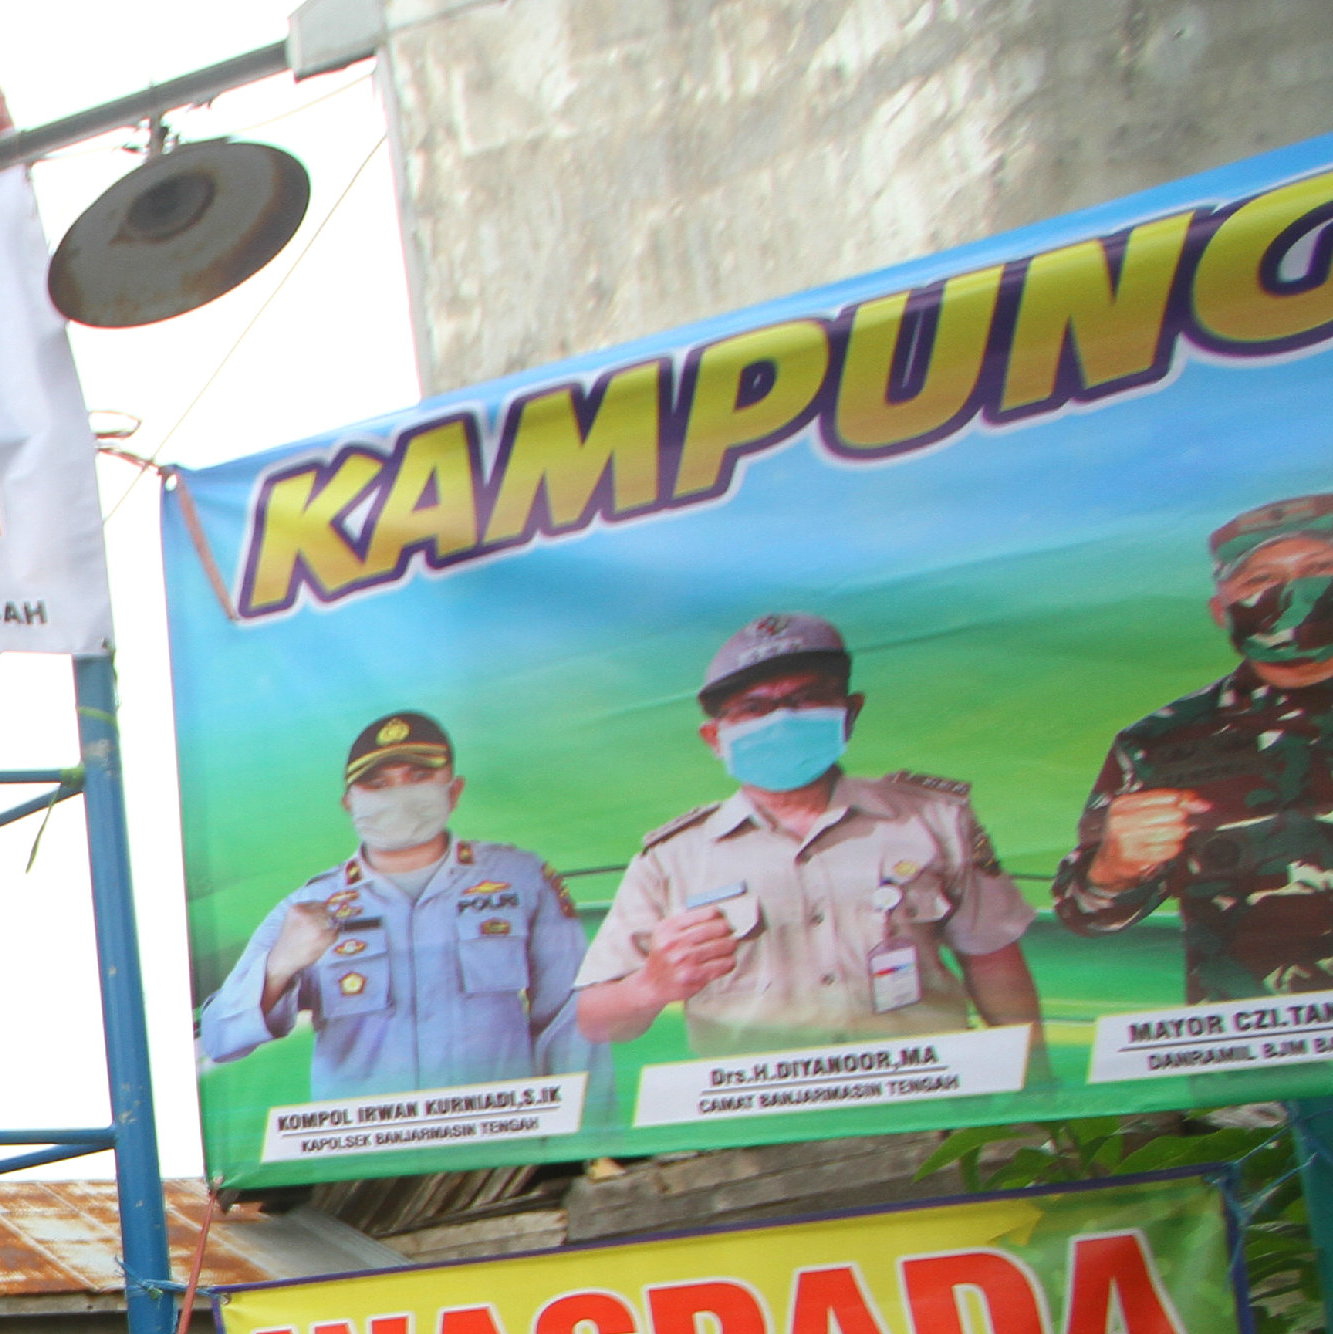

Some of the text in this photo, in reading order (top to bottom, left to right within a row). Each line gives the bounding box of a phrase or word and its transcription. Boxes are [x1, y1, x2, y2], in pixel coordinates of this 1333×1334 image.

[238, 172, 1333, 618] KAMPUNG
[1128, 1014, 1223, 1044] MAYOR
[698, 1074, 960, 1114] CAMAT BANJARMASIN TENGAH
[278, 1108, 353, 1131] KOMPOL
[357, 1101, 419, 1123] IRWAN
[302, 1117, 540, 1151] KAPOLSEK BANJARMASIN TENGAH
